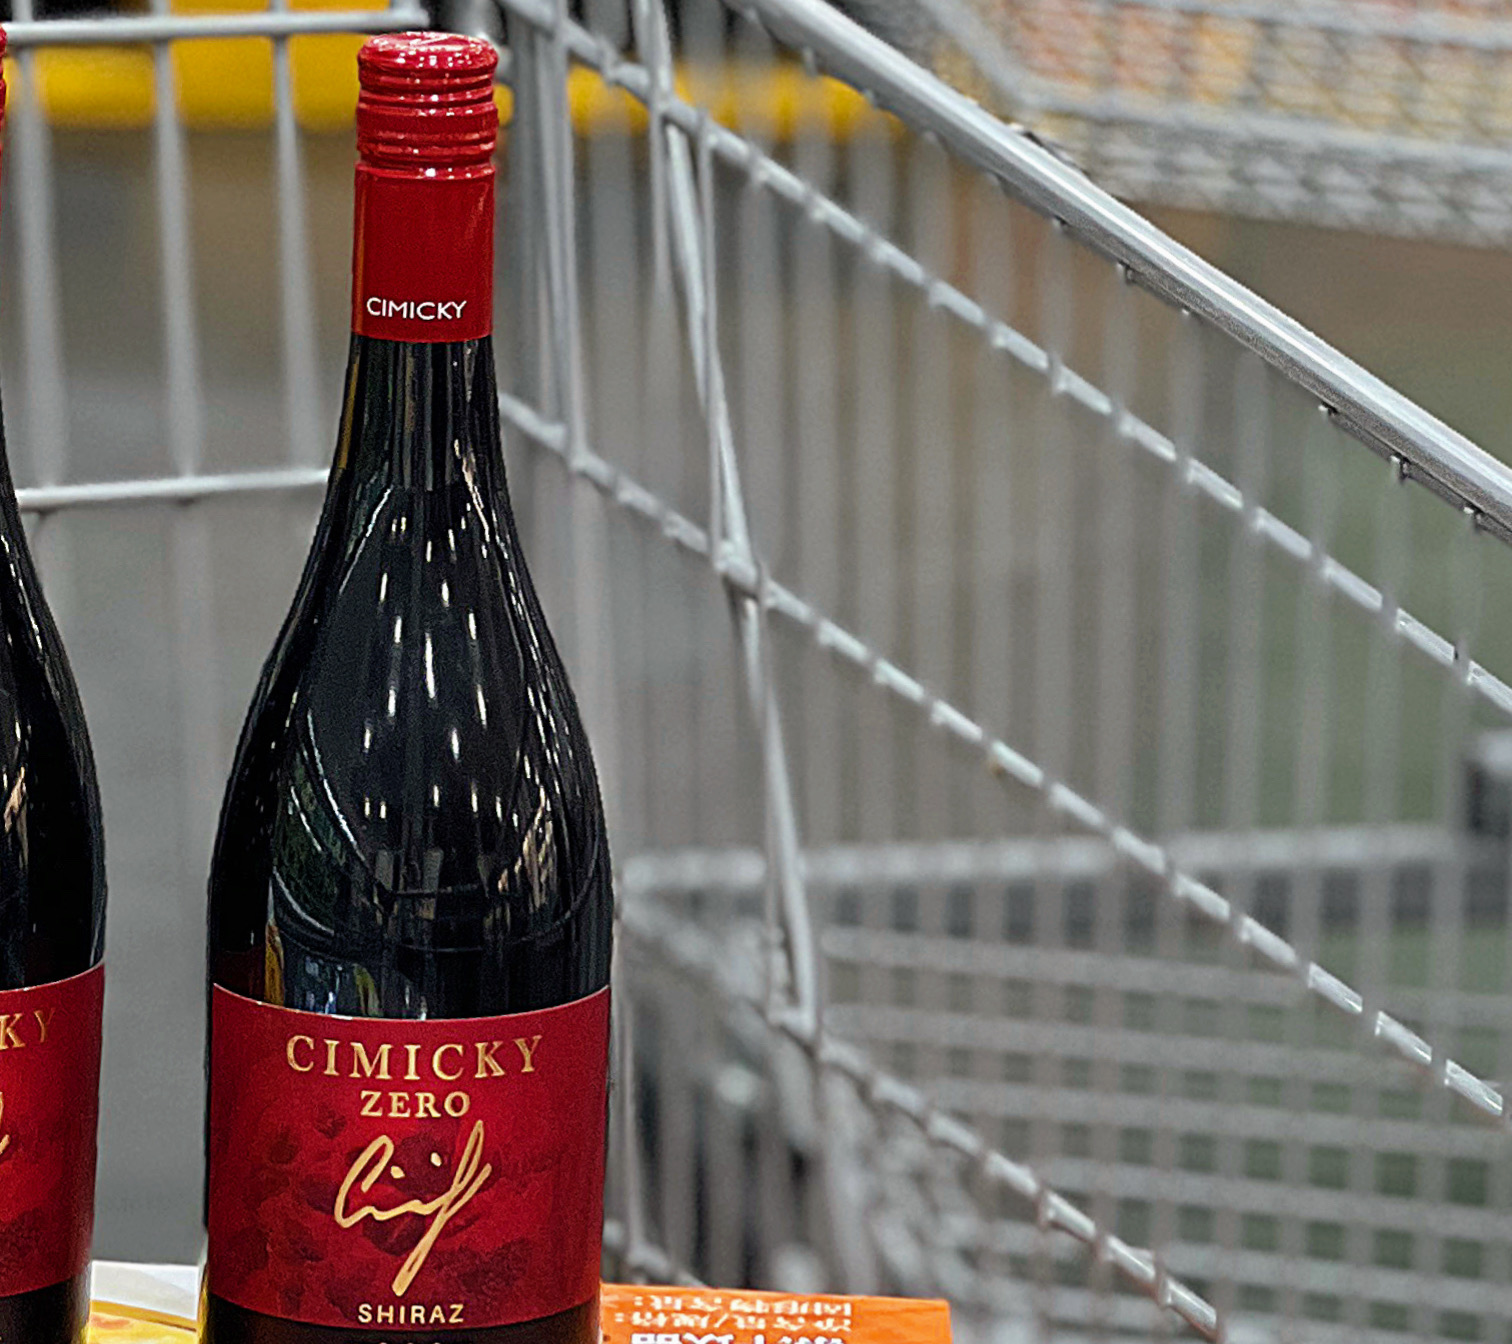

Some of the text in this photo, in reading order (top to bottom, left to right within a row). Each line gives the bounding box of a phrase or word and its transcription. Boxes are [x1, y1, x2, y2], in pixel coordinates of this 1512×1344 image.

[366, 296, 467, 322] CIMICKY
[286, 1034, 544, 1082] CIMICKY
[360, 1089, 472, 1119] ZERO
[358, 1302, 465, 1326] SHIRAZ
